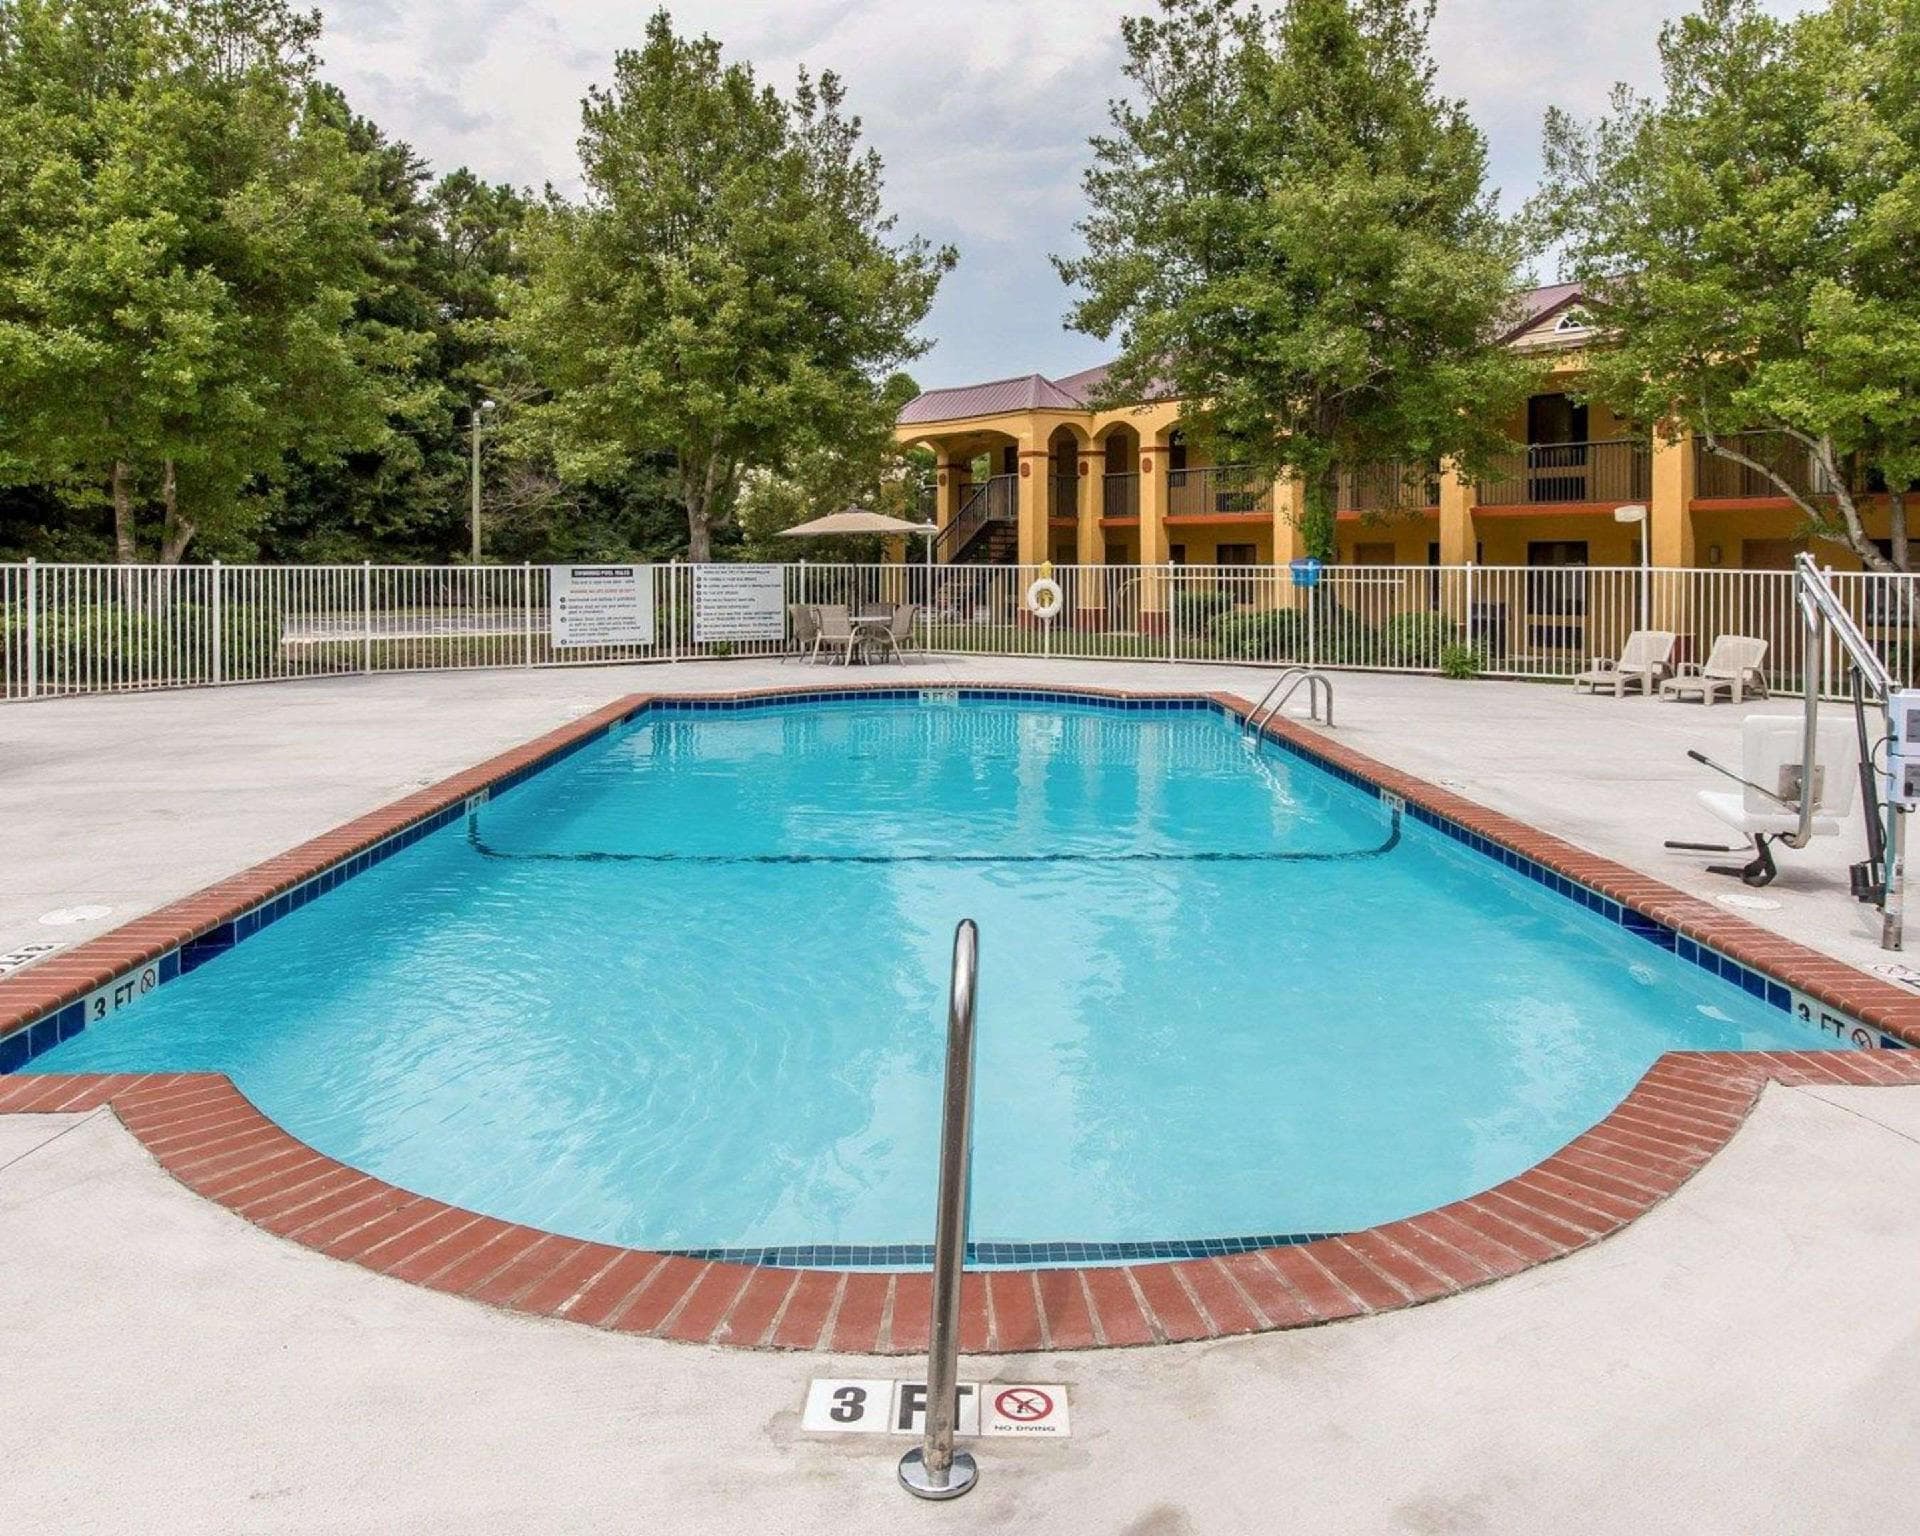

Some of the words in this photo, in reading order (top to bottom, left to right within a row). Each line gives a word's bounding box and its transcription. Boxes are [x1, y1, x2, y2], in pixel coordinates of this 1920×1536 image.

[94, 997, 106, 1022] 3
[114, 980, 135, 1011] FT
[1797, 1003, 1810, 1023] 3
[1821, 1013, 1845, 1038] FT
[830, 1386, 867, 1423] 3
